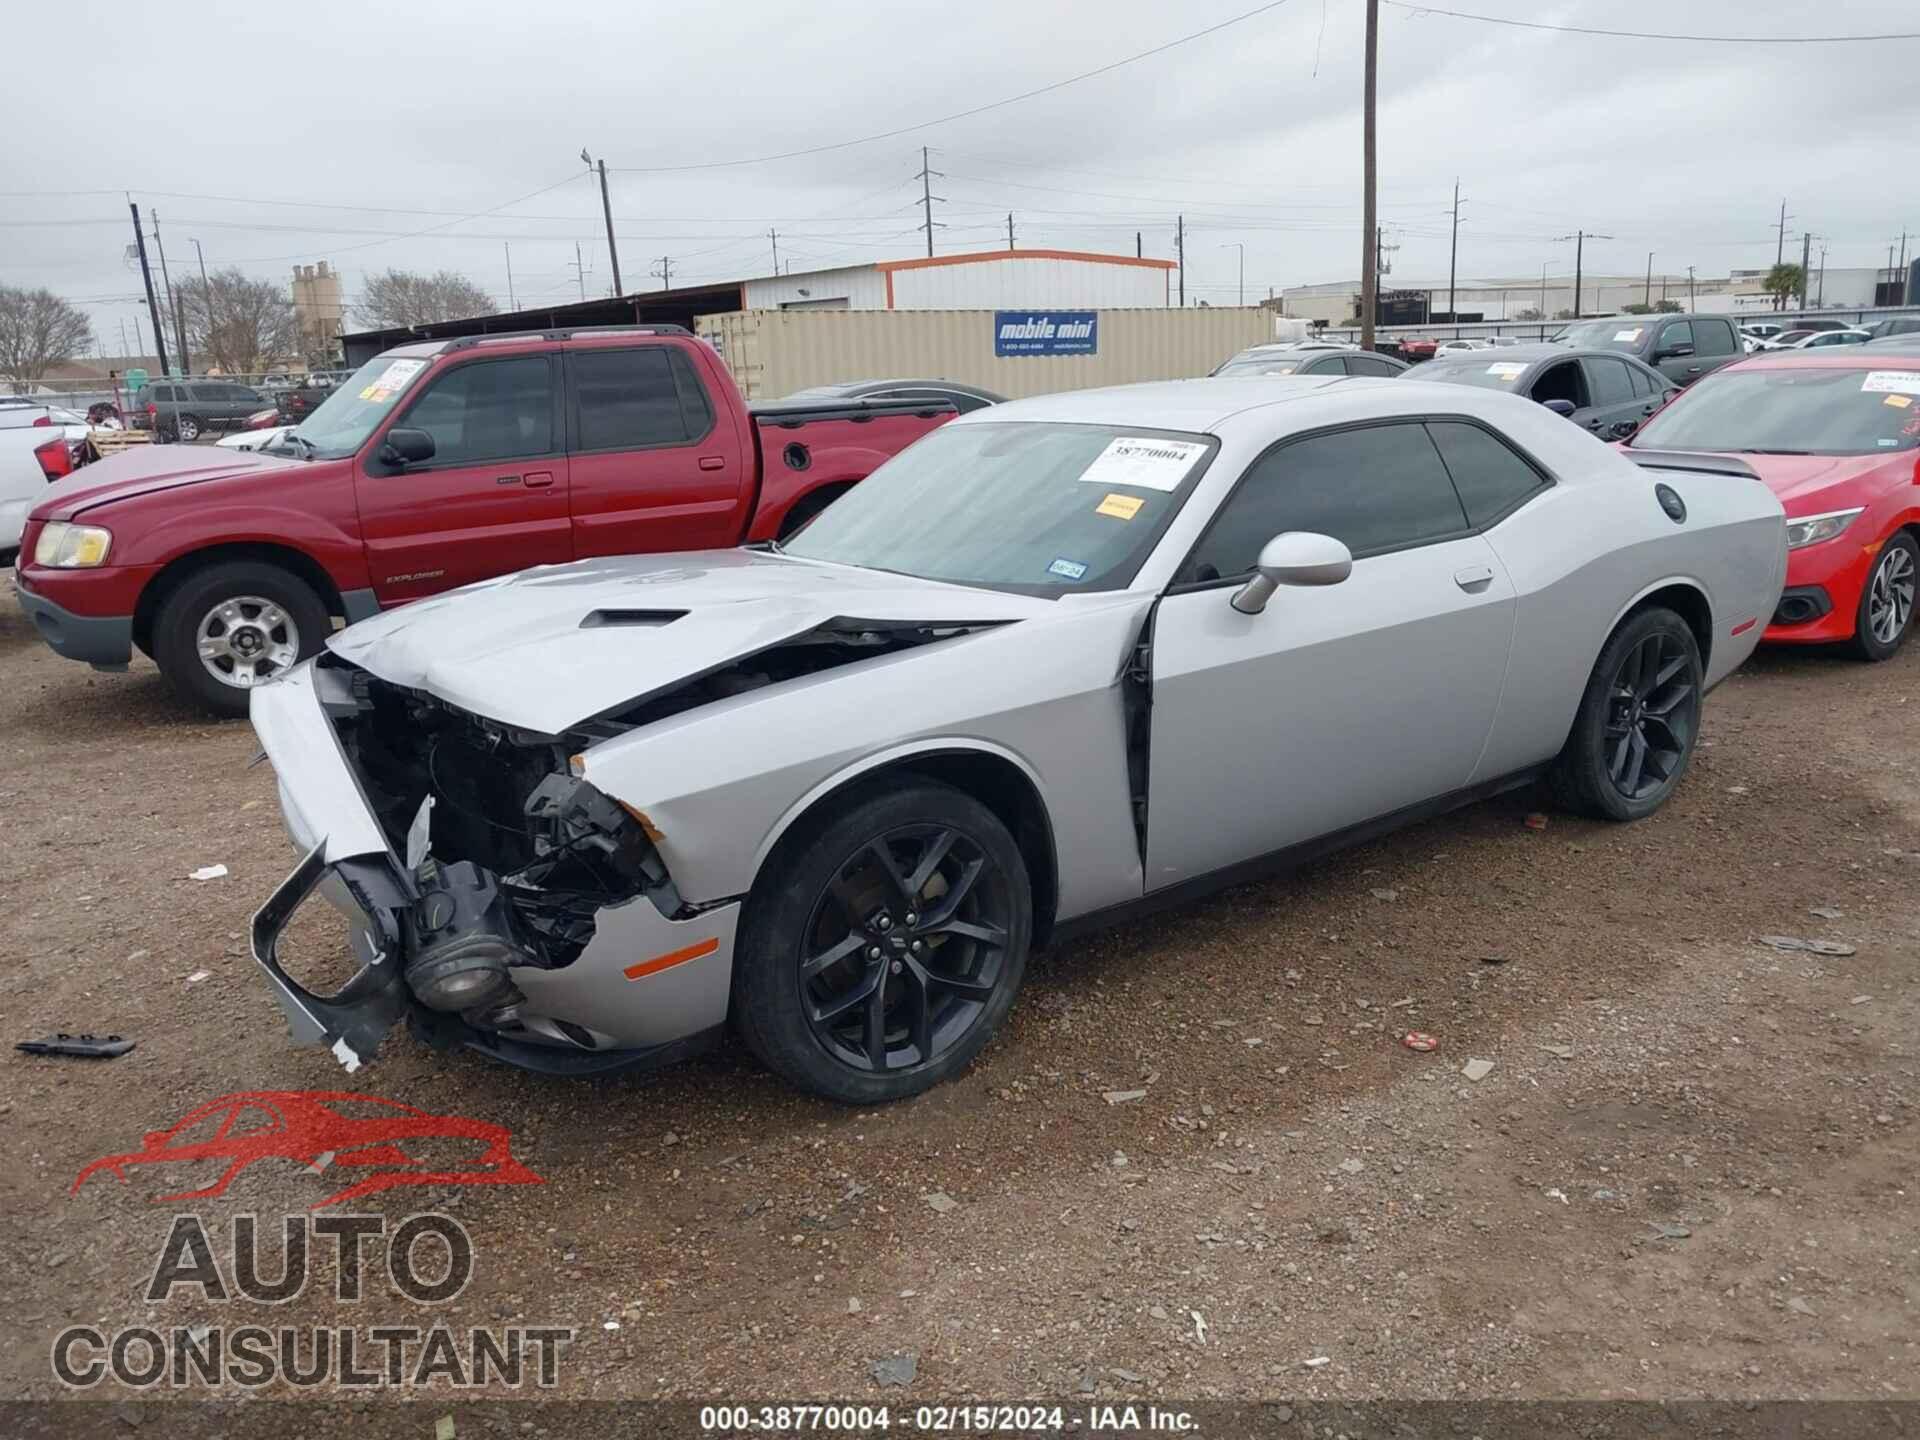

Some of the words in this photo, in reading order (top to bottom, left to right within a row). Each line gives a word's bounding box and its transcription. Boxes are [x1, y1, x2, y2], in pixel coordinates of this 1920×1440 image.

[1000, 317, 1055, 338] mobile
[1057, 320, 1094, 338] mini
[386, 569, 445, 584] EXPLORER
